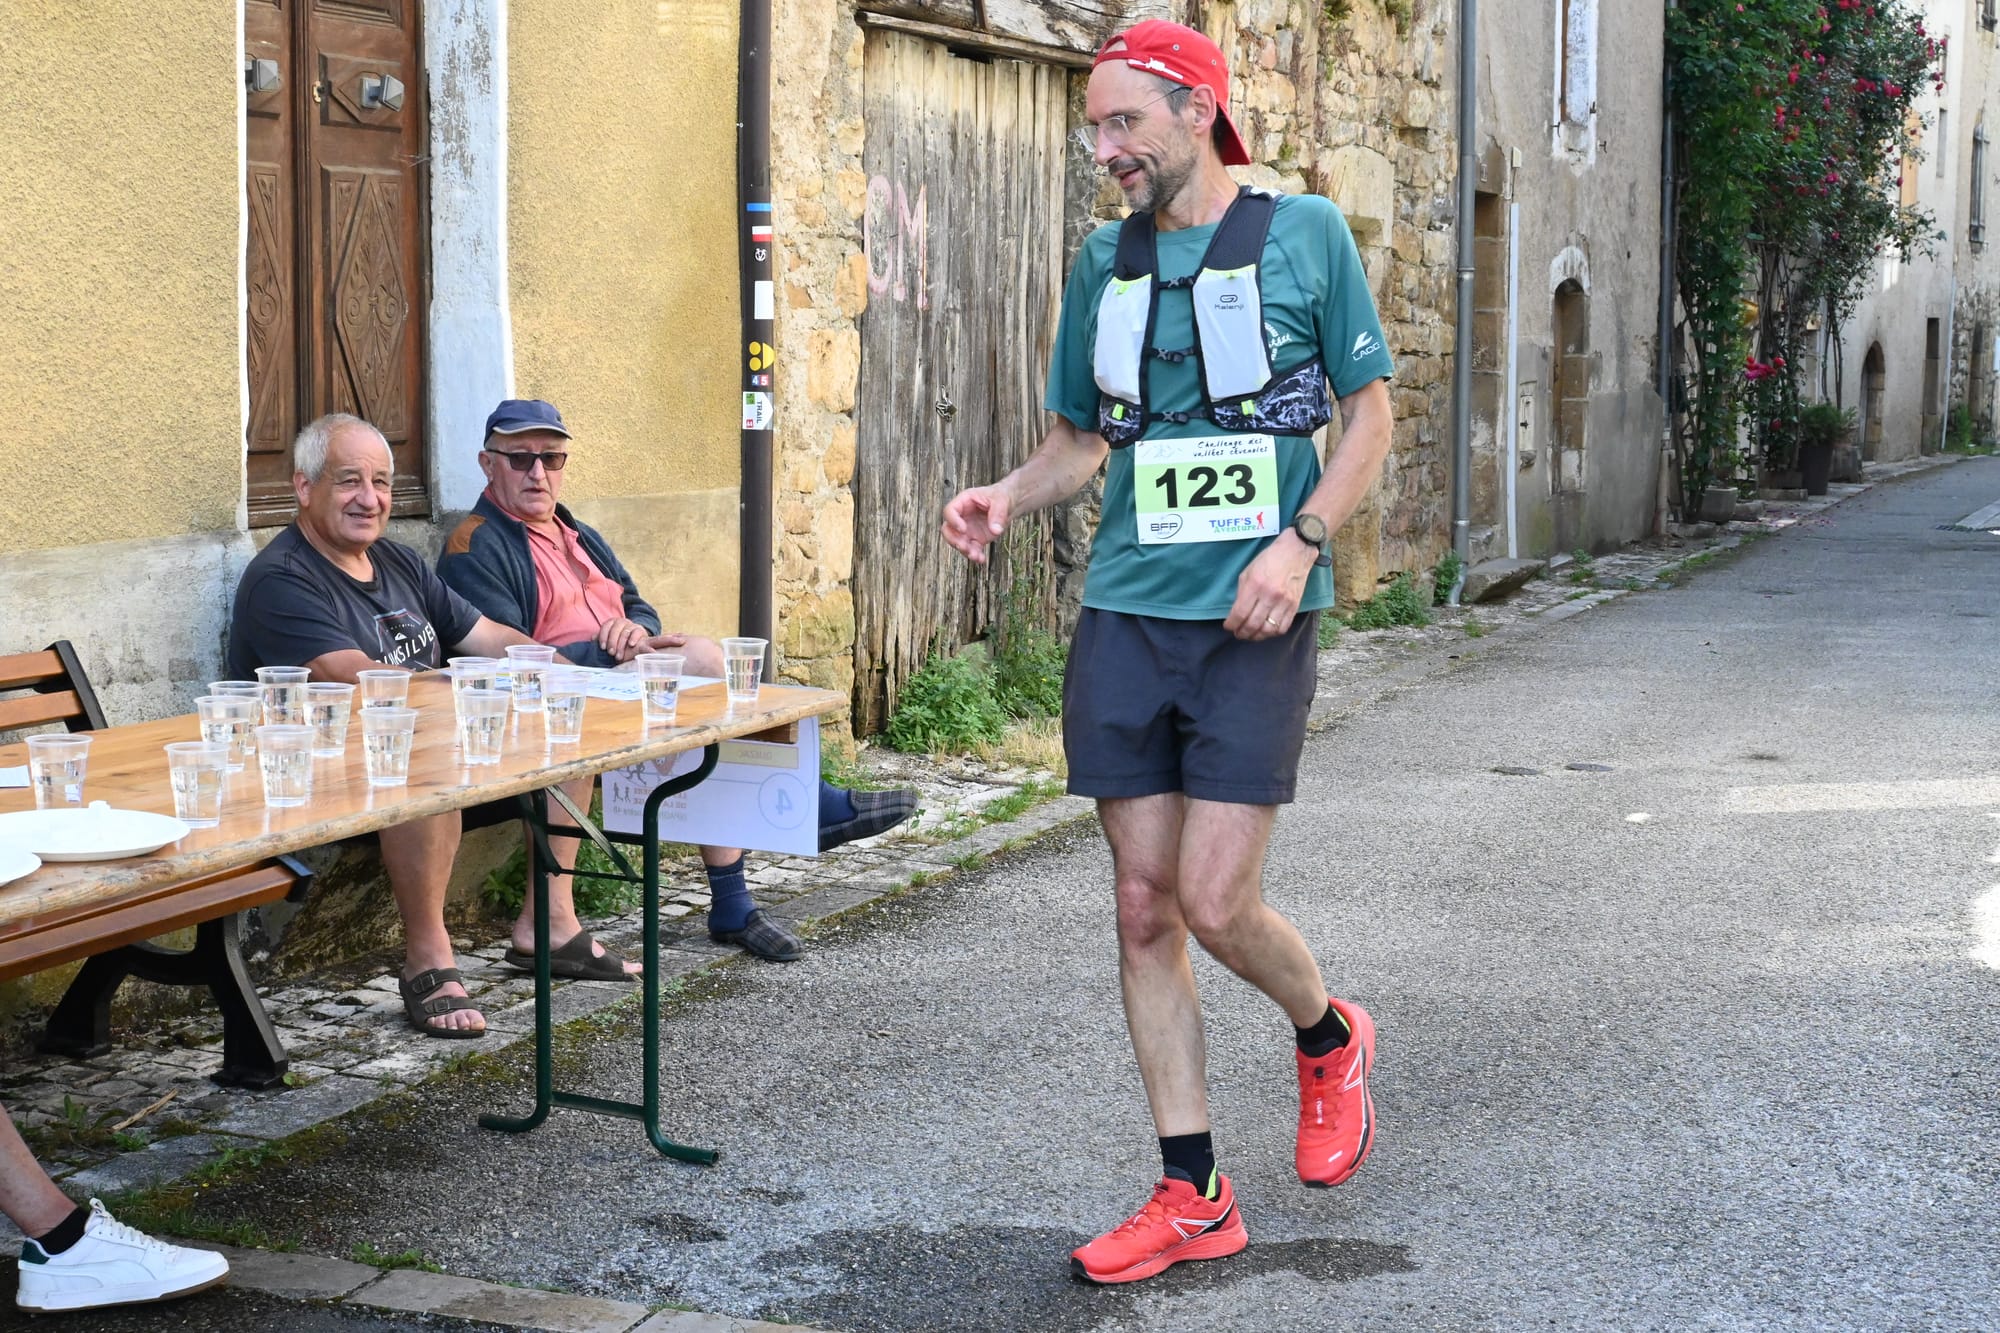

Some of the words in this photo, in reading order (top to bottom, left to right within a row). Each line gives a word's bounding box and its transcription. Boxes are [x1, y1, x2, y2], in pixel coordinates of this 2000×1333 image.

[1198, 440, 1242, 449] Challenge
[1155, 464, 1256, 508] 123
[1208, 517, 1252, 527] TUFF'S
[1150, 523, 1178, 532] BFP
